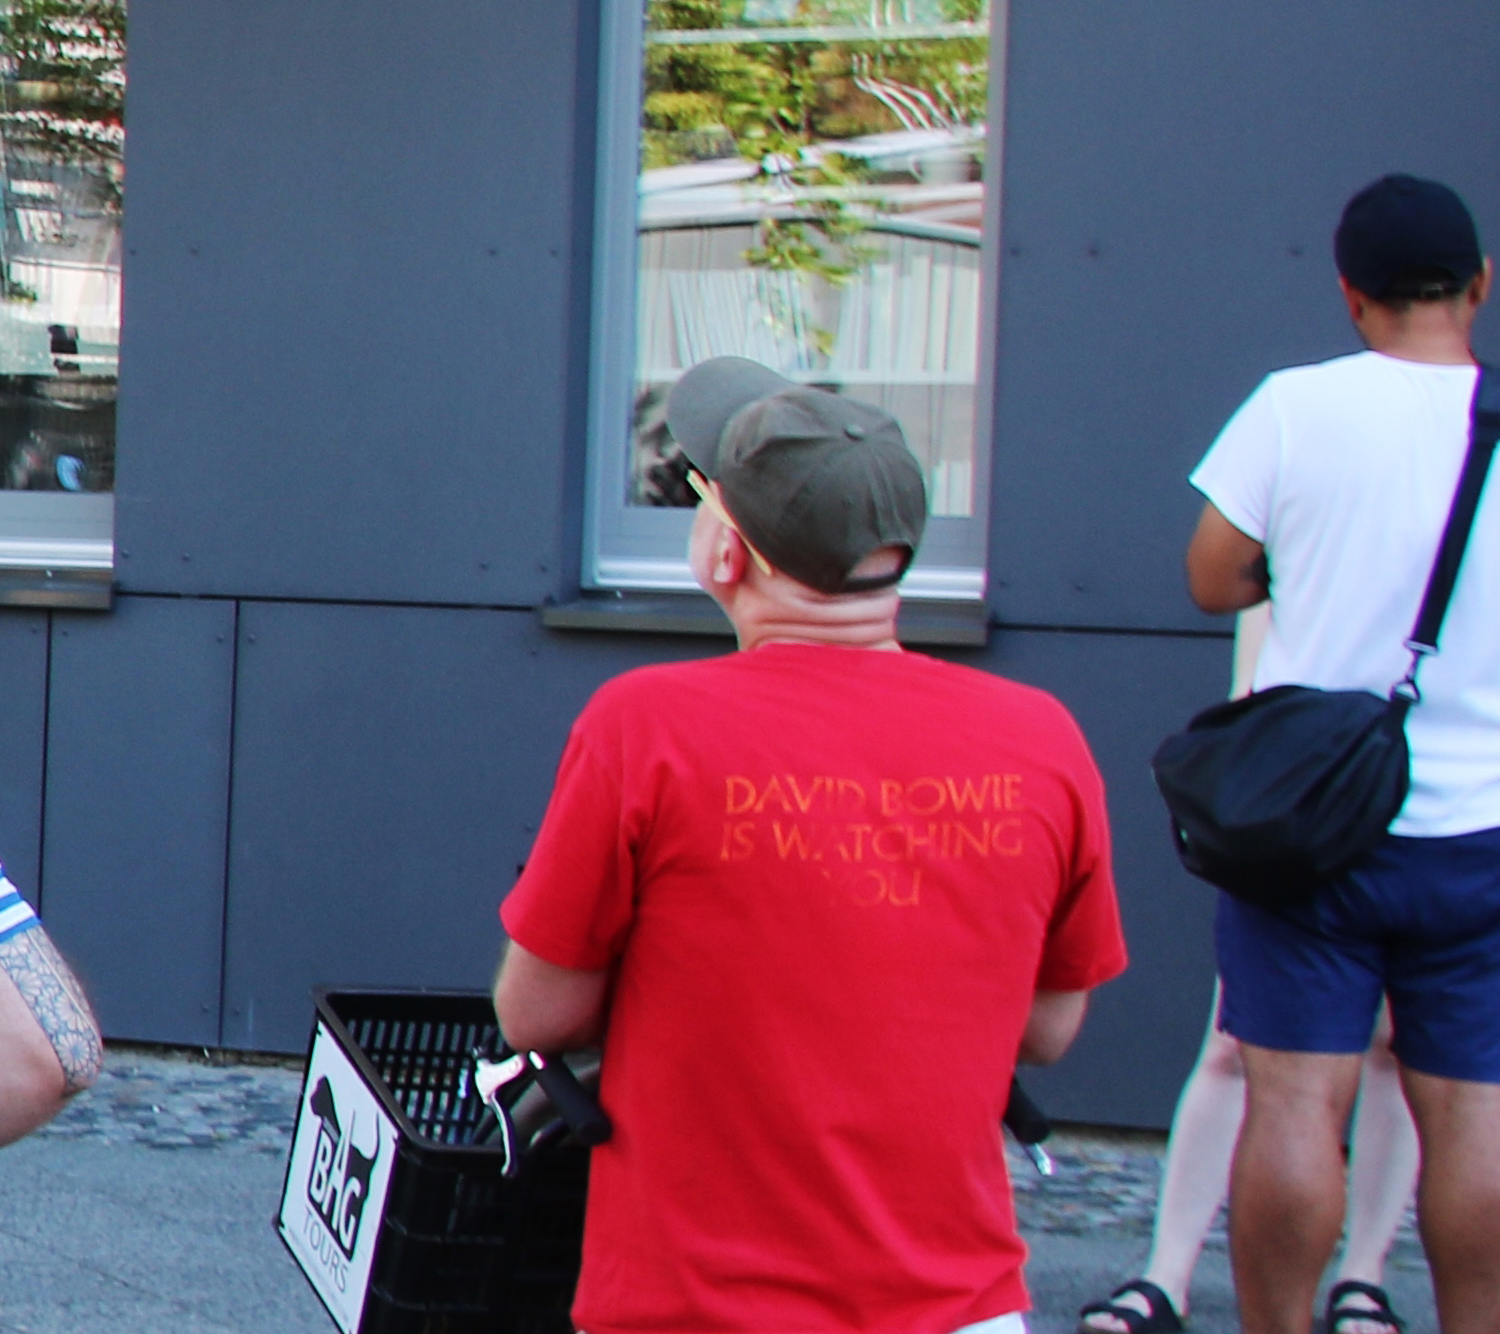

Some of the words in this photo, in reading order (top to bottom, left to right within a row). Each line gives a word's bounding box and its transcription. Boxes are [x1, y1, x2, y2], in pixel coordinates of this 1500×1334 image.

[724, 774, 866, 815] DAVID
[880, 773, 1023, 817] BOWIE
[720, 820, 756, 862] IS
[821, 869, 922, 907] OU
[309, 1110, 362, 1251] BAG
[303, 1204, 349, 1294] TOURS
